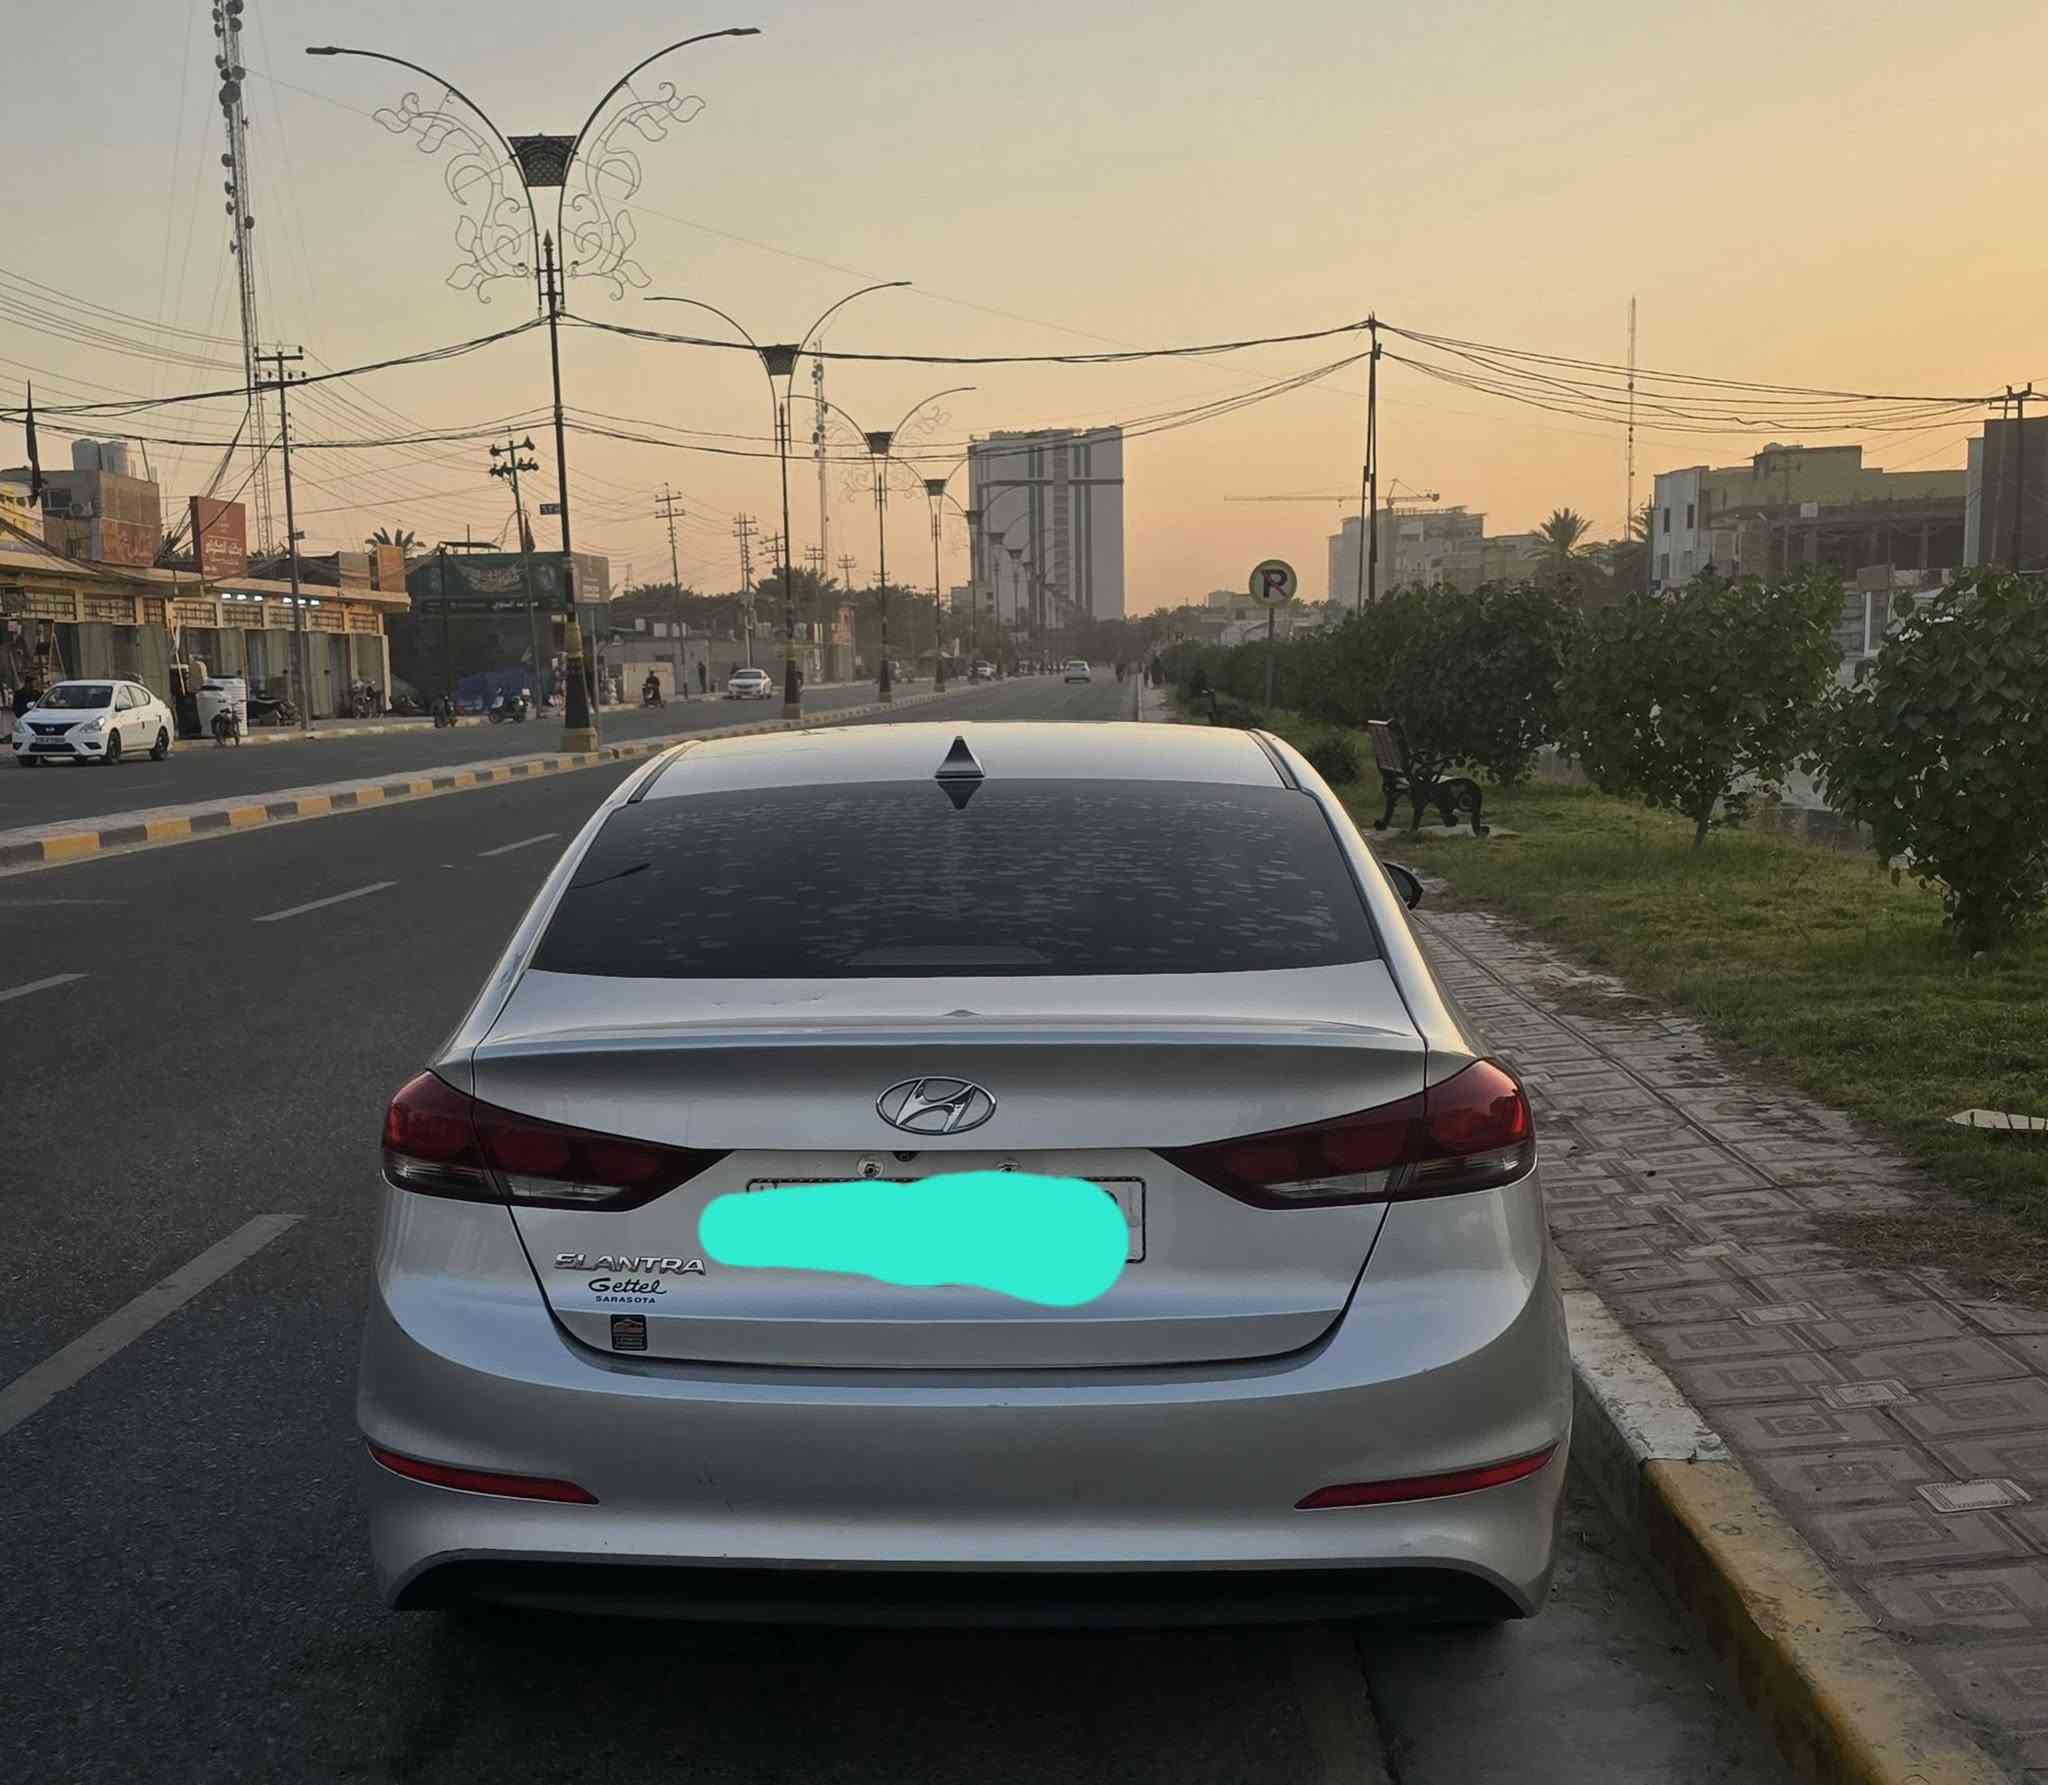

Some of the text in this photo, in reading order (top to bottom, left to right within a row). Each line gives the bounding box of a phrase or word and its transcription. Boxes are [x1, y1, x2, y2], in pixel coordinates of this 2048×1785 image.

[554, 1252, 706, 1276] ELANTRA
[588, 1277, 667, 1295] Gettel
[595, 1295, 656, 1304] SARASOTA
